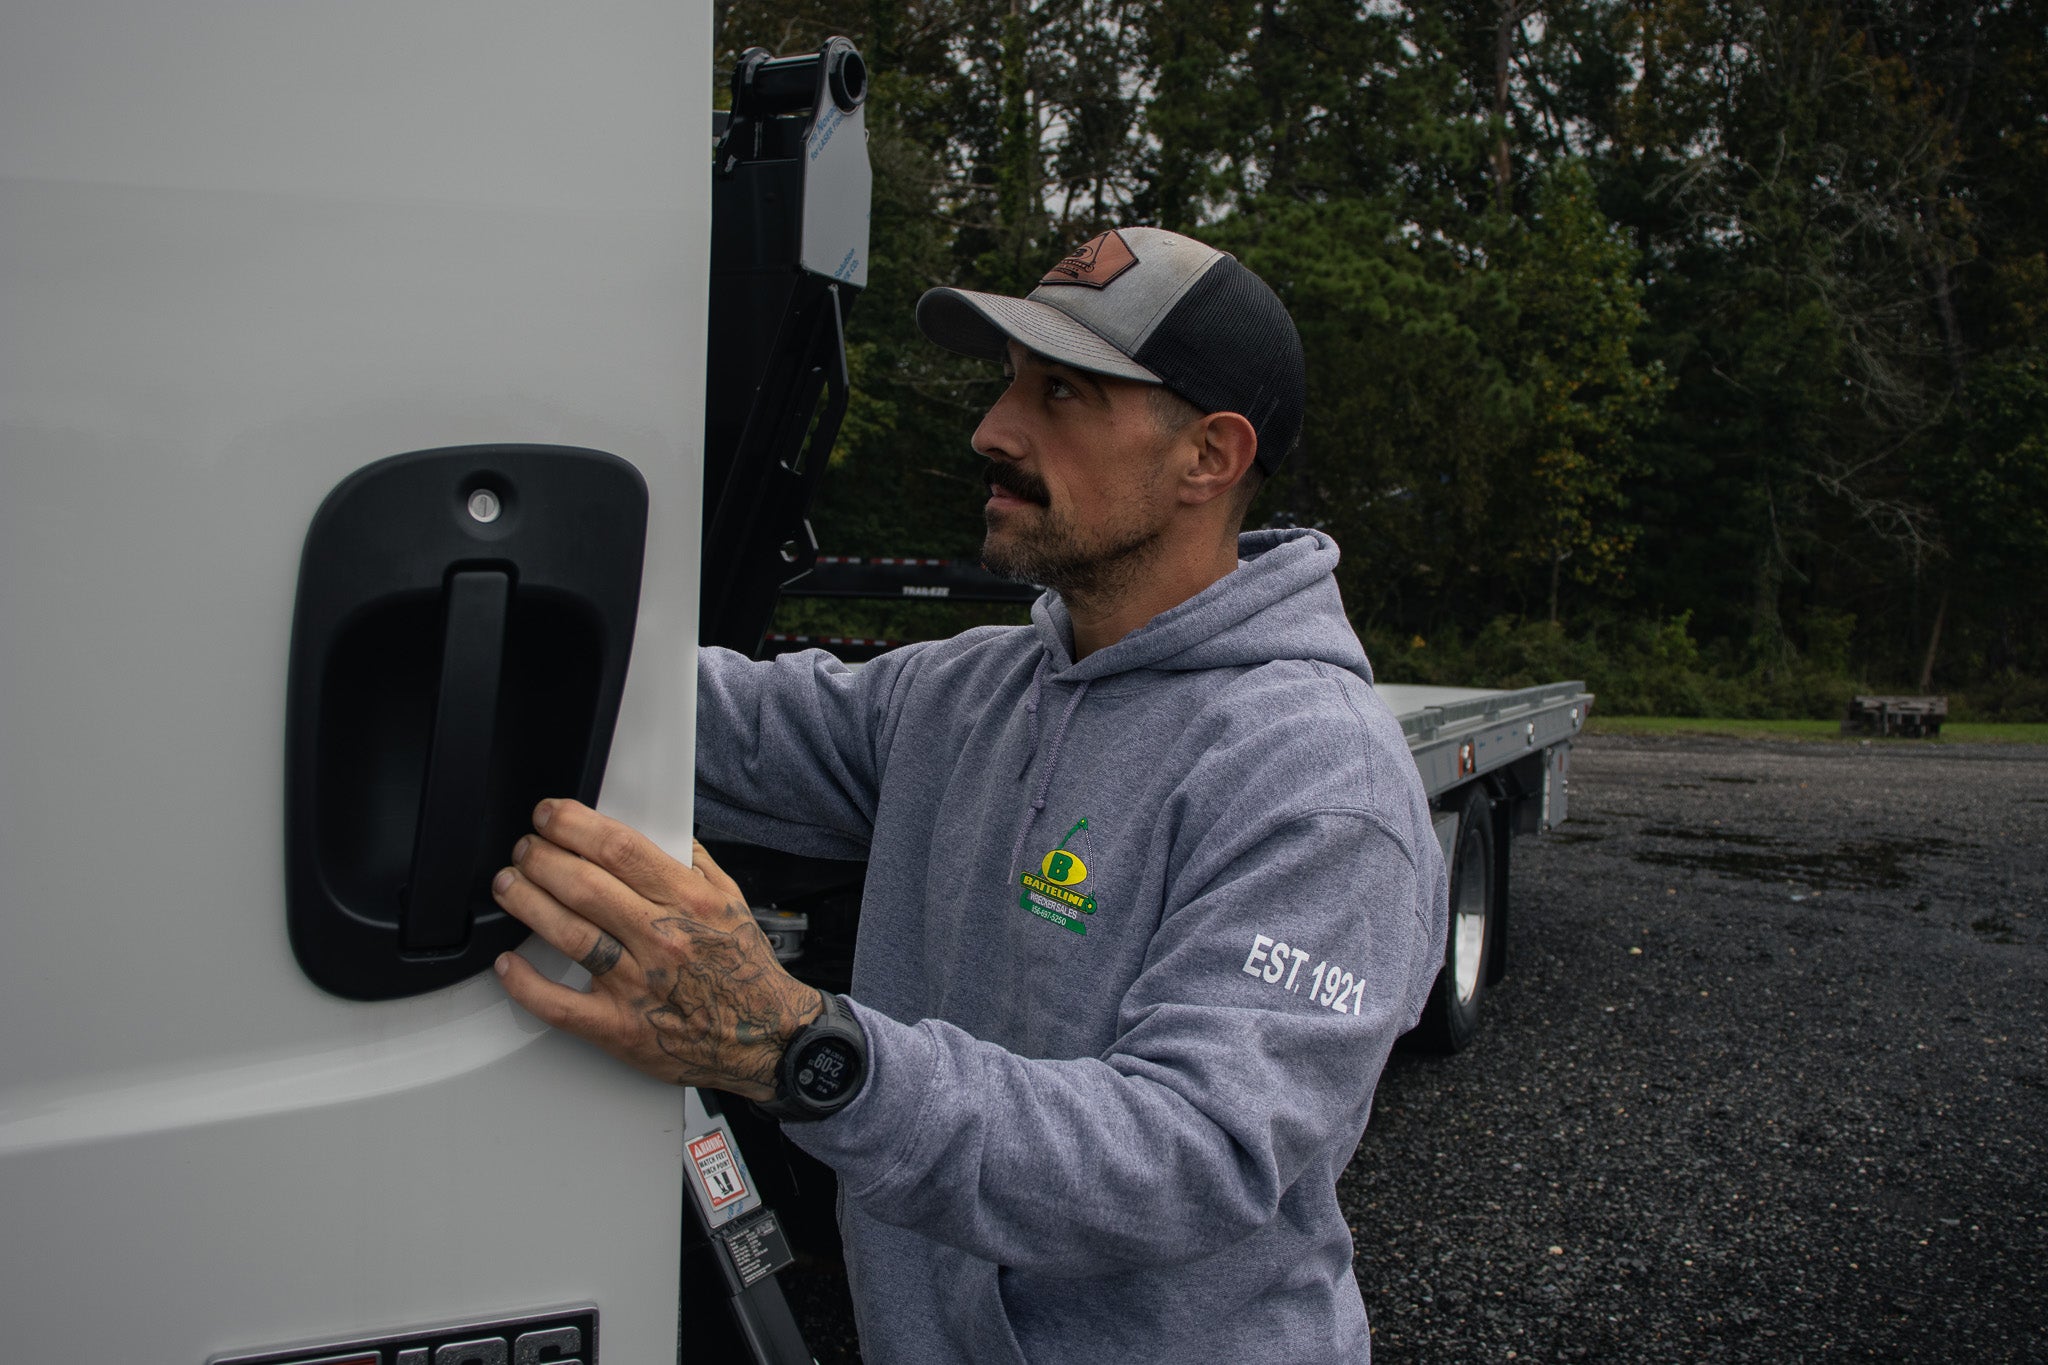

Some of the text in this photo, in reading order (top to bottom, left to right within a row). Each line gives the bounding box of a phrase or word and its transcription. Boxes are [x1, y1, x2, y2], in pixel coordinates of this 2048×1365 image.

[1047, 852, 1073, 882] B
[1023, 875, 1084, 907] BATTELINI
[1055, 903, 1078, 920] SALES
[1309, 961, 1366, 1016] 1921
[813, 1053, 844, 1077] 2:09
[699, 1151, 727, 1168] WATCH FEET
[702, 1159, 730, 1176] PINCH POINT
